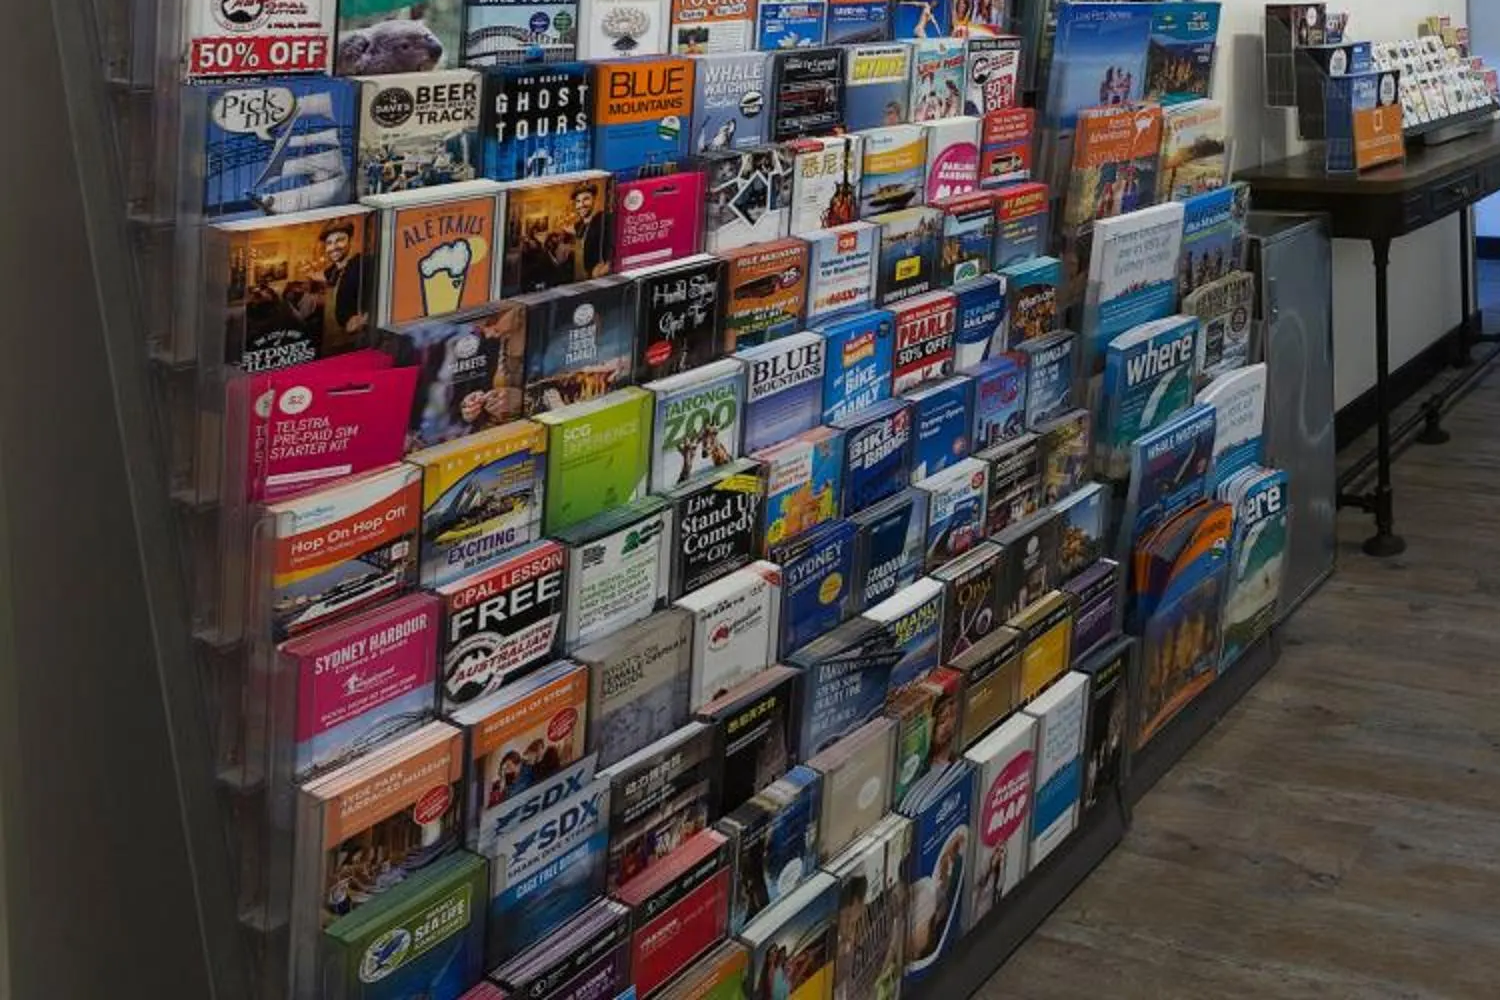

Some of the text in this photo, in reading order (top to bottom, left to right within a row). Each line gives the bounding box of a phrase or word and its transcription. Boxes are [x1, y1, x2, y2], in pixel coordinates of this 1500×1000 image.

[200, 41, 325, 67] 50% OFF
[609, 67, 685, 99] BLUE
[704, 62, 764, 83] WHALE
[221, 89, 278, 118] Pick
[416, 83, 478, 104] BEER
[495, 85, 589, 114] GHOST
[608, 98, 683, 116] MOUNTAINS
[245, 106, 285, 129] me
[416, 108, 476, 125] TRACK
[495, 114, 588, 143] TOURS
[402, 215, 487, 248] ALE TRAILS
[753, 343, 822, 386] BLUE
[1126, 333, 1194, 386] where
[752, 364, 822, 396] MOUNTAINS
[664, 382, 736, 418] TARONGA
[273, 425, 359, 447] PRE-PAID SIM
[275, 416, 332, 434] TELSTRA
[662, 400, 736, 450] ZOO
[849, 418, 893, 459] BIKE
[269, 438, 350, 461] STARTER KIT
[681, 490, 762, 535] Stand Up
[686, 494, 717, 516] Live
[291, 505, 407, 555] Hop On Hop Off
[447, 527, 517, 565] EXCITING
[683, 511, 756, 555] Comedy
[788, 540, 843, 584] SYDNEY
[451, 571, 561, 642] FREE
[453, 580, 497, 609] OPAL
[314, 613, 428, 676] SYDNEY HARBOUR
[519, 768, 585, 823] SDX
[538, 791, 599, 850] SDX
